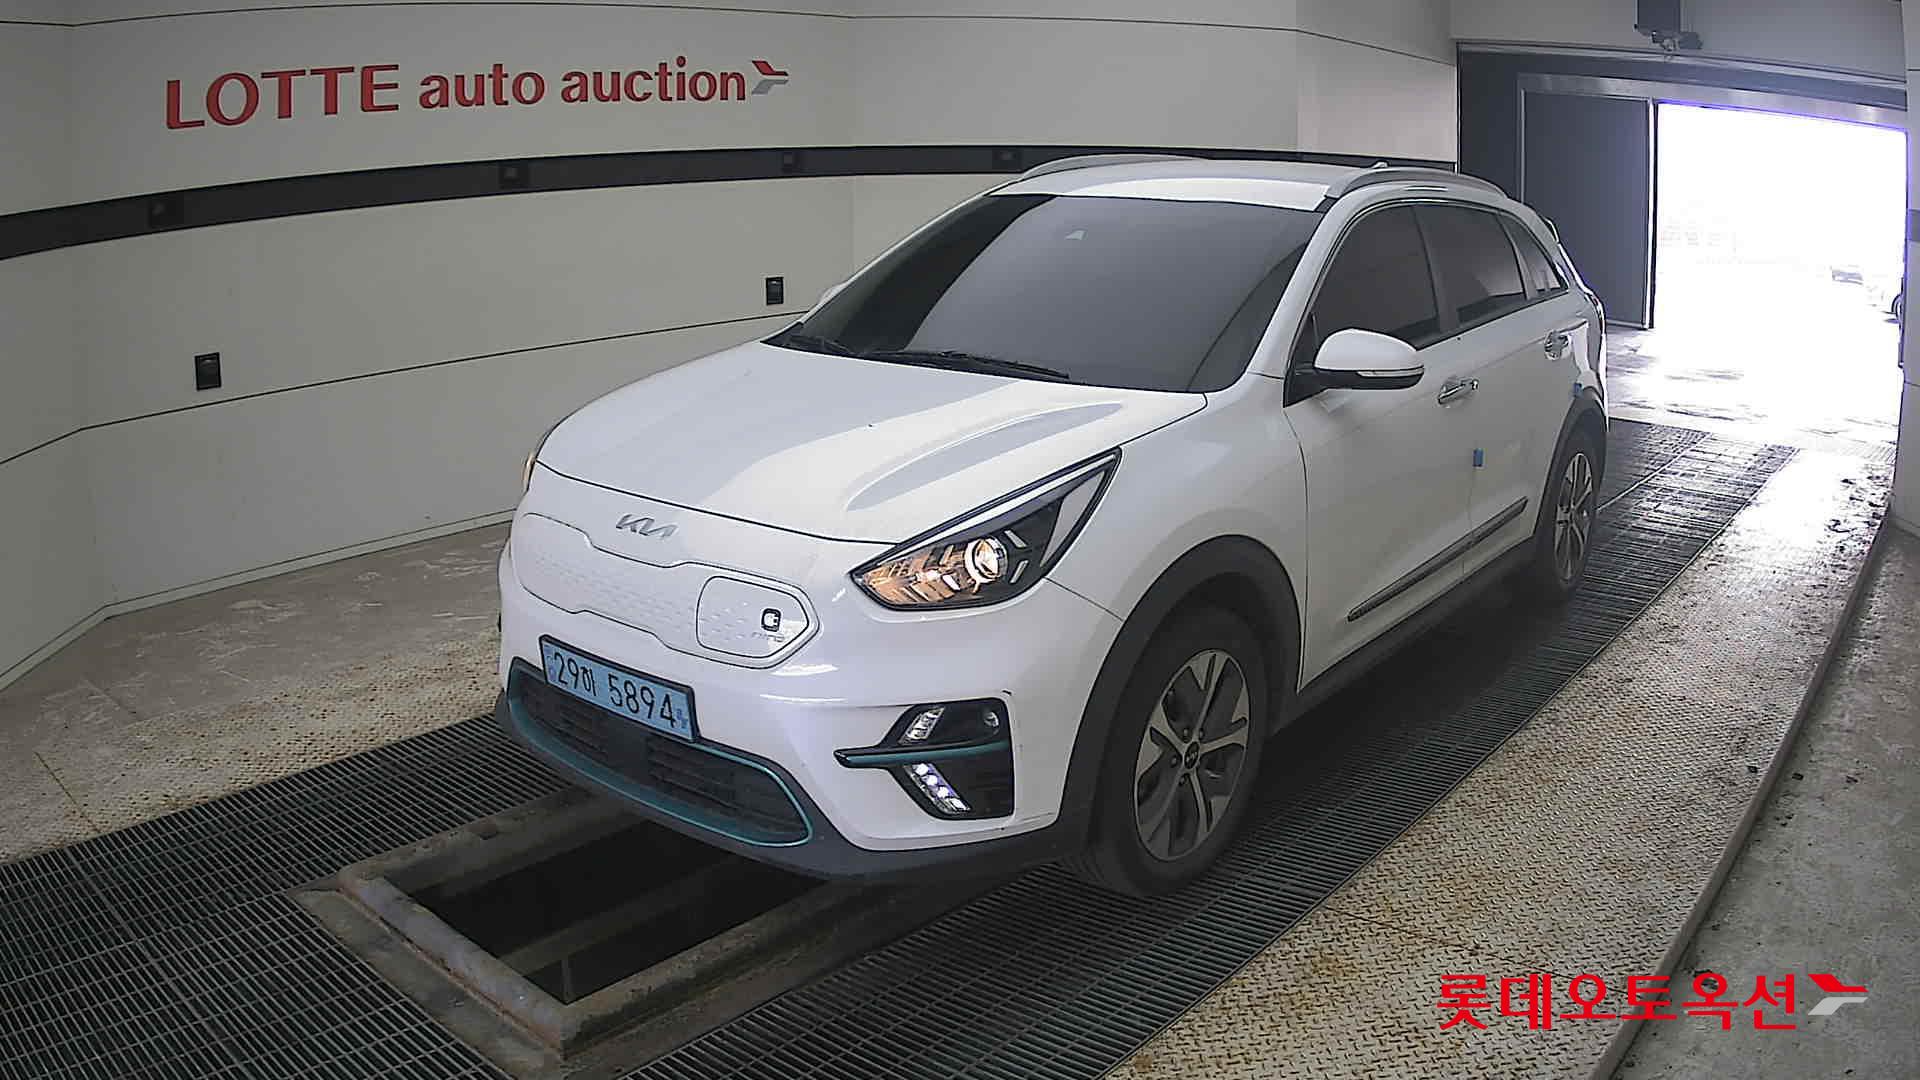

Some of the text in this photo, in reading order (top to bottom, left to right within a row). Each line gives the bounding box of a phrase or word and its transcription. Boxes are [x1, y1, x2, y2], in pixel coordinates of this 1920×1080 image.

[165, 56, 746, 130] LOTTE auto auction
[607, 672, 676, 729] 5894
